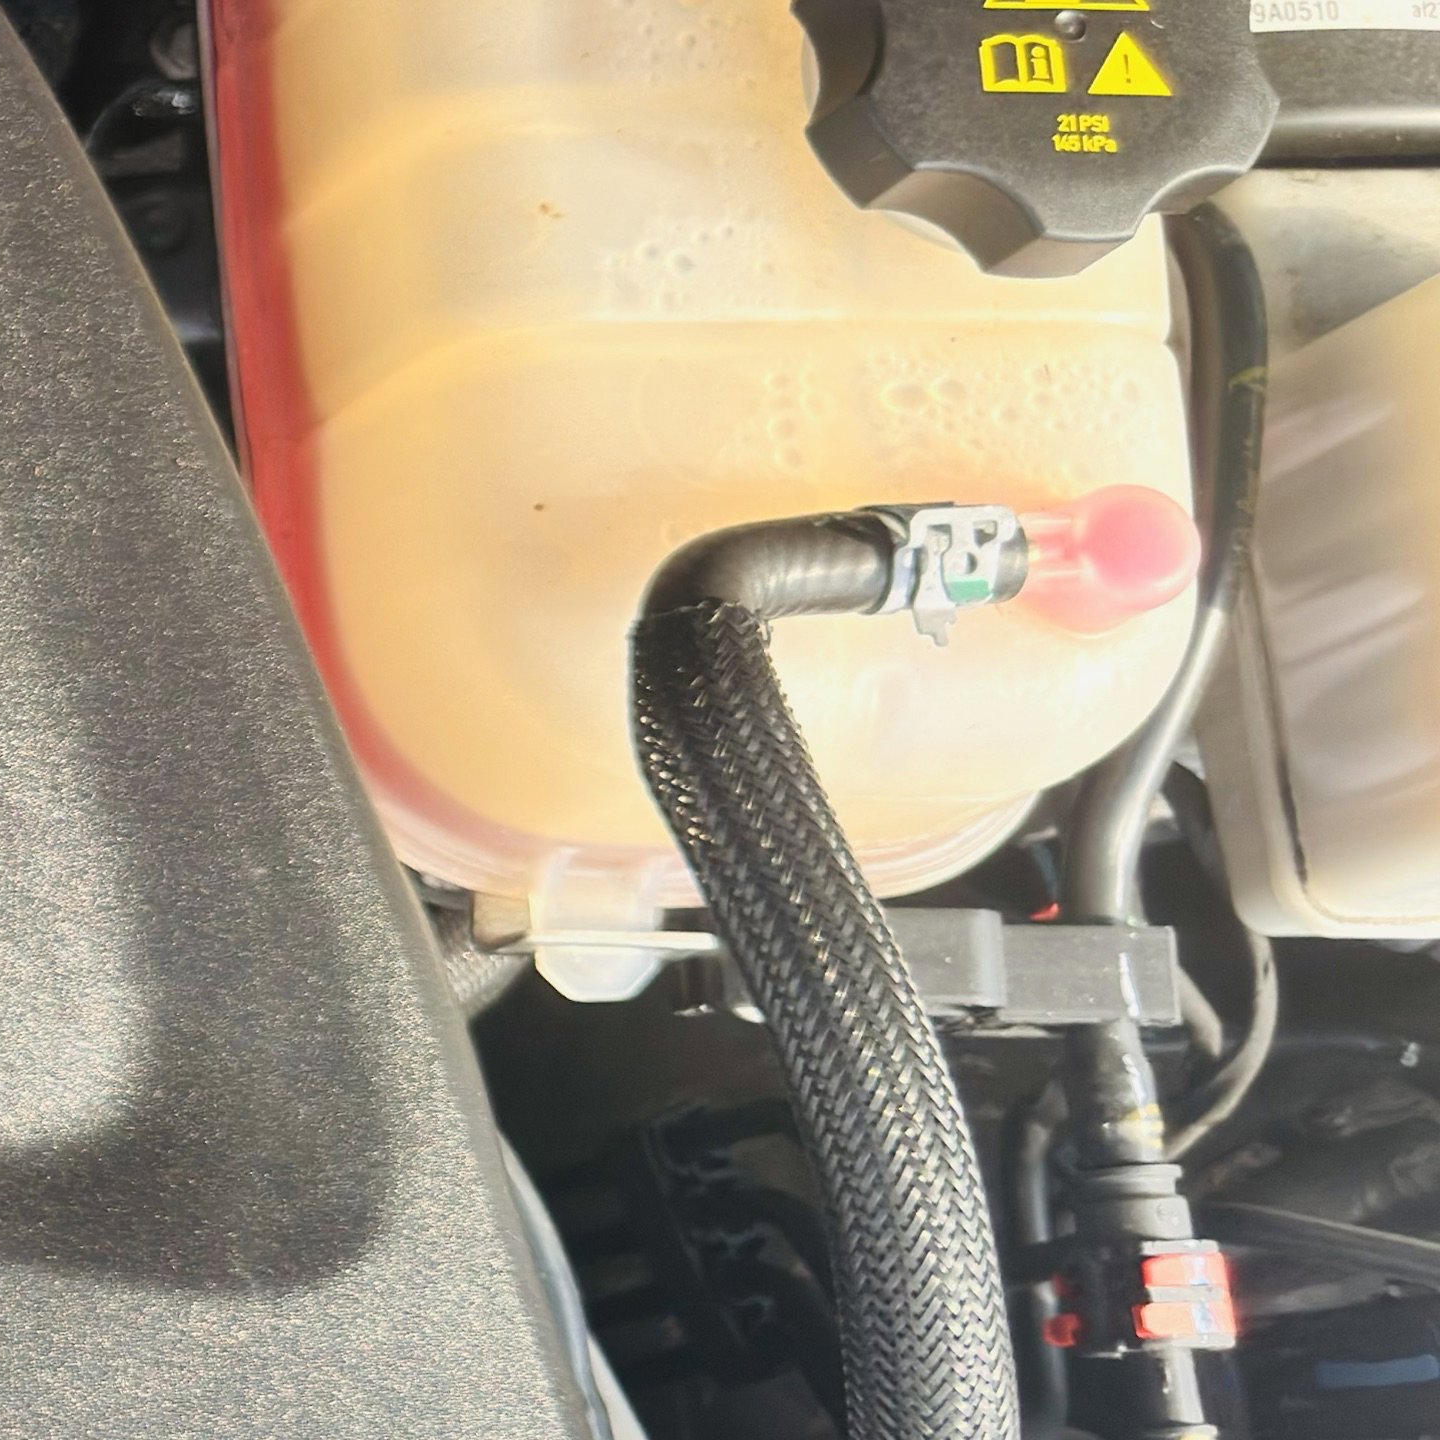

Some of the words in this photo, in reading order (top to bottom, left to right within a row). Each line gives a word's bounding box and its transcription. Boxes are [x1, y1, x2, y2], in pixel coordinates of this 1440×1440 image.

[1056, 114, 1077, 132] 21
[1078, 114, 1110, 133] PSI
[1051, 133, 1081, 152] 145
[1082, 134, 1118, 153] kPa
